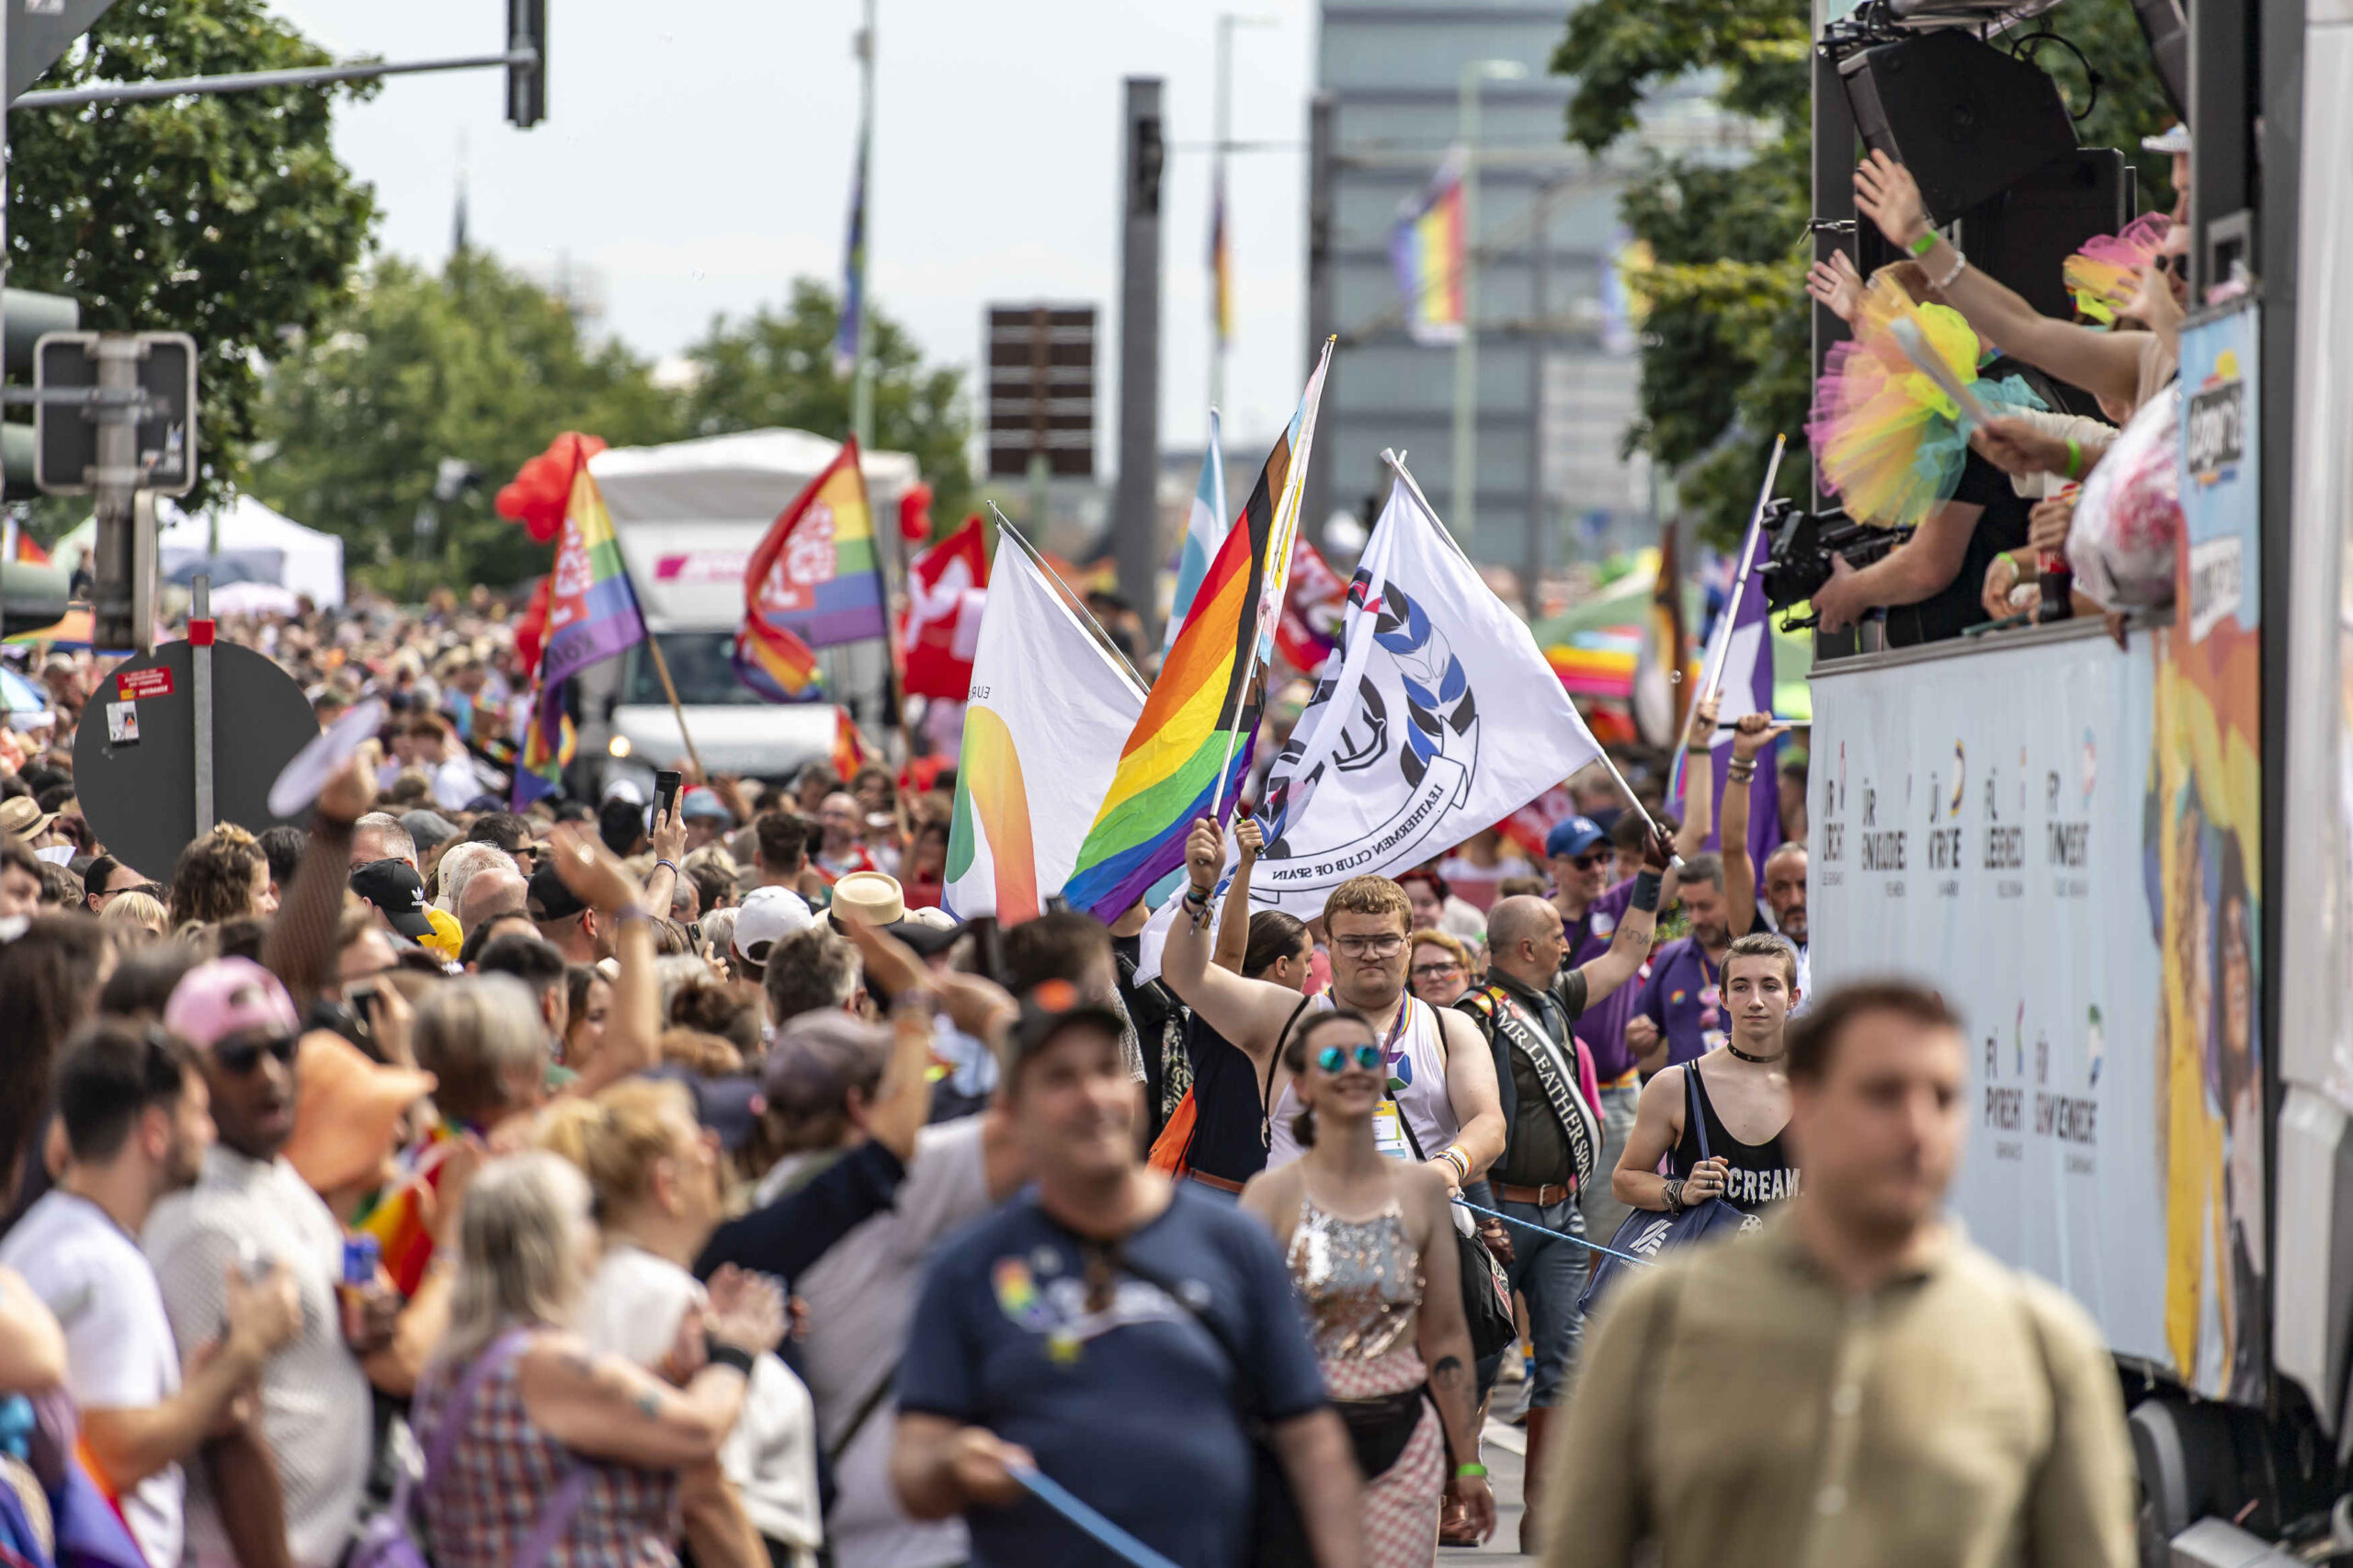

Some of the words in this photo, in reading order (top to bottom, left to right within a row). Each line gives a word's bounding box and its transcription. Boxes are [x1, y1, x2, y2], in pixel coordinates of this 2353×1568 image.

[1497, 1010, 1527, 1050] MR.
[1529, 1043, 1585, 1146] LEATHER
[1716, 1167, 1802, 1205] CREAM
